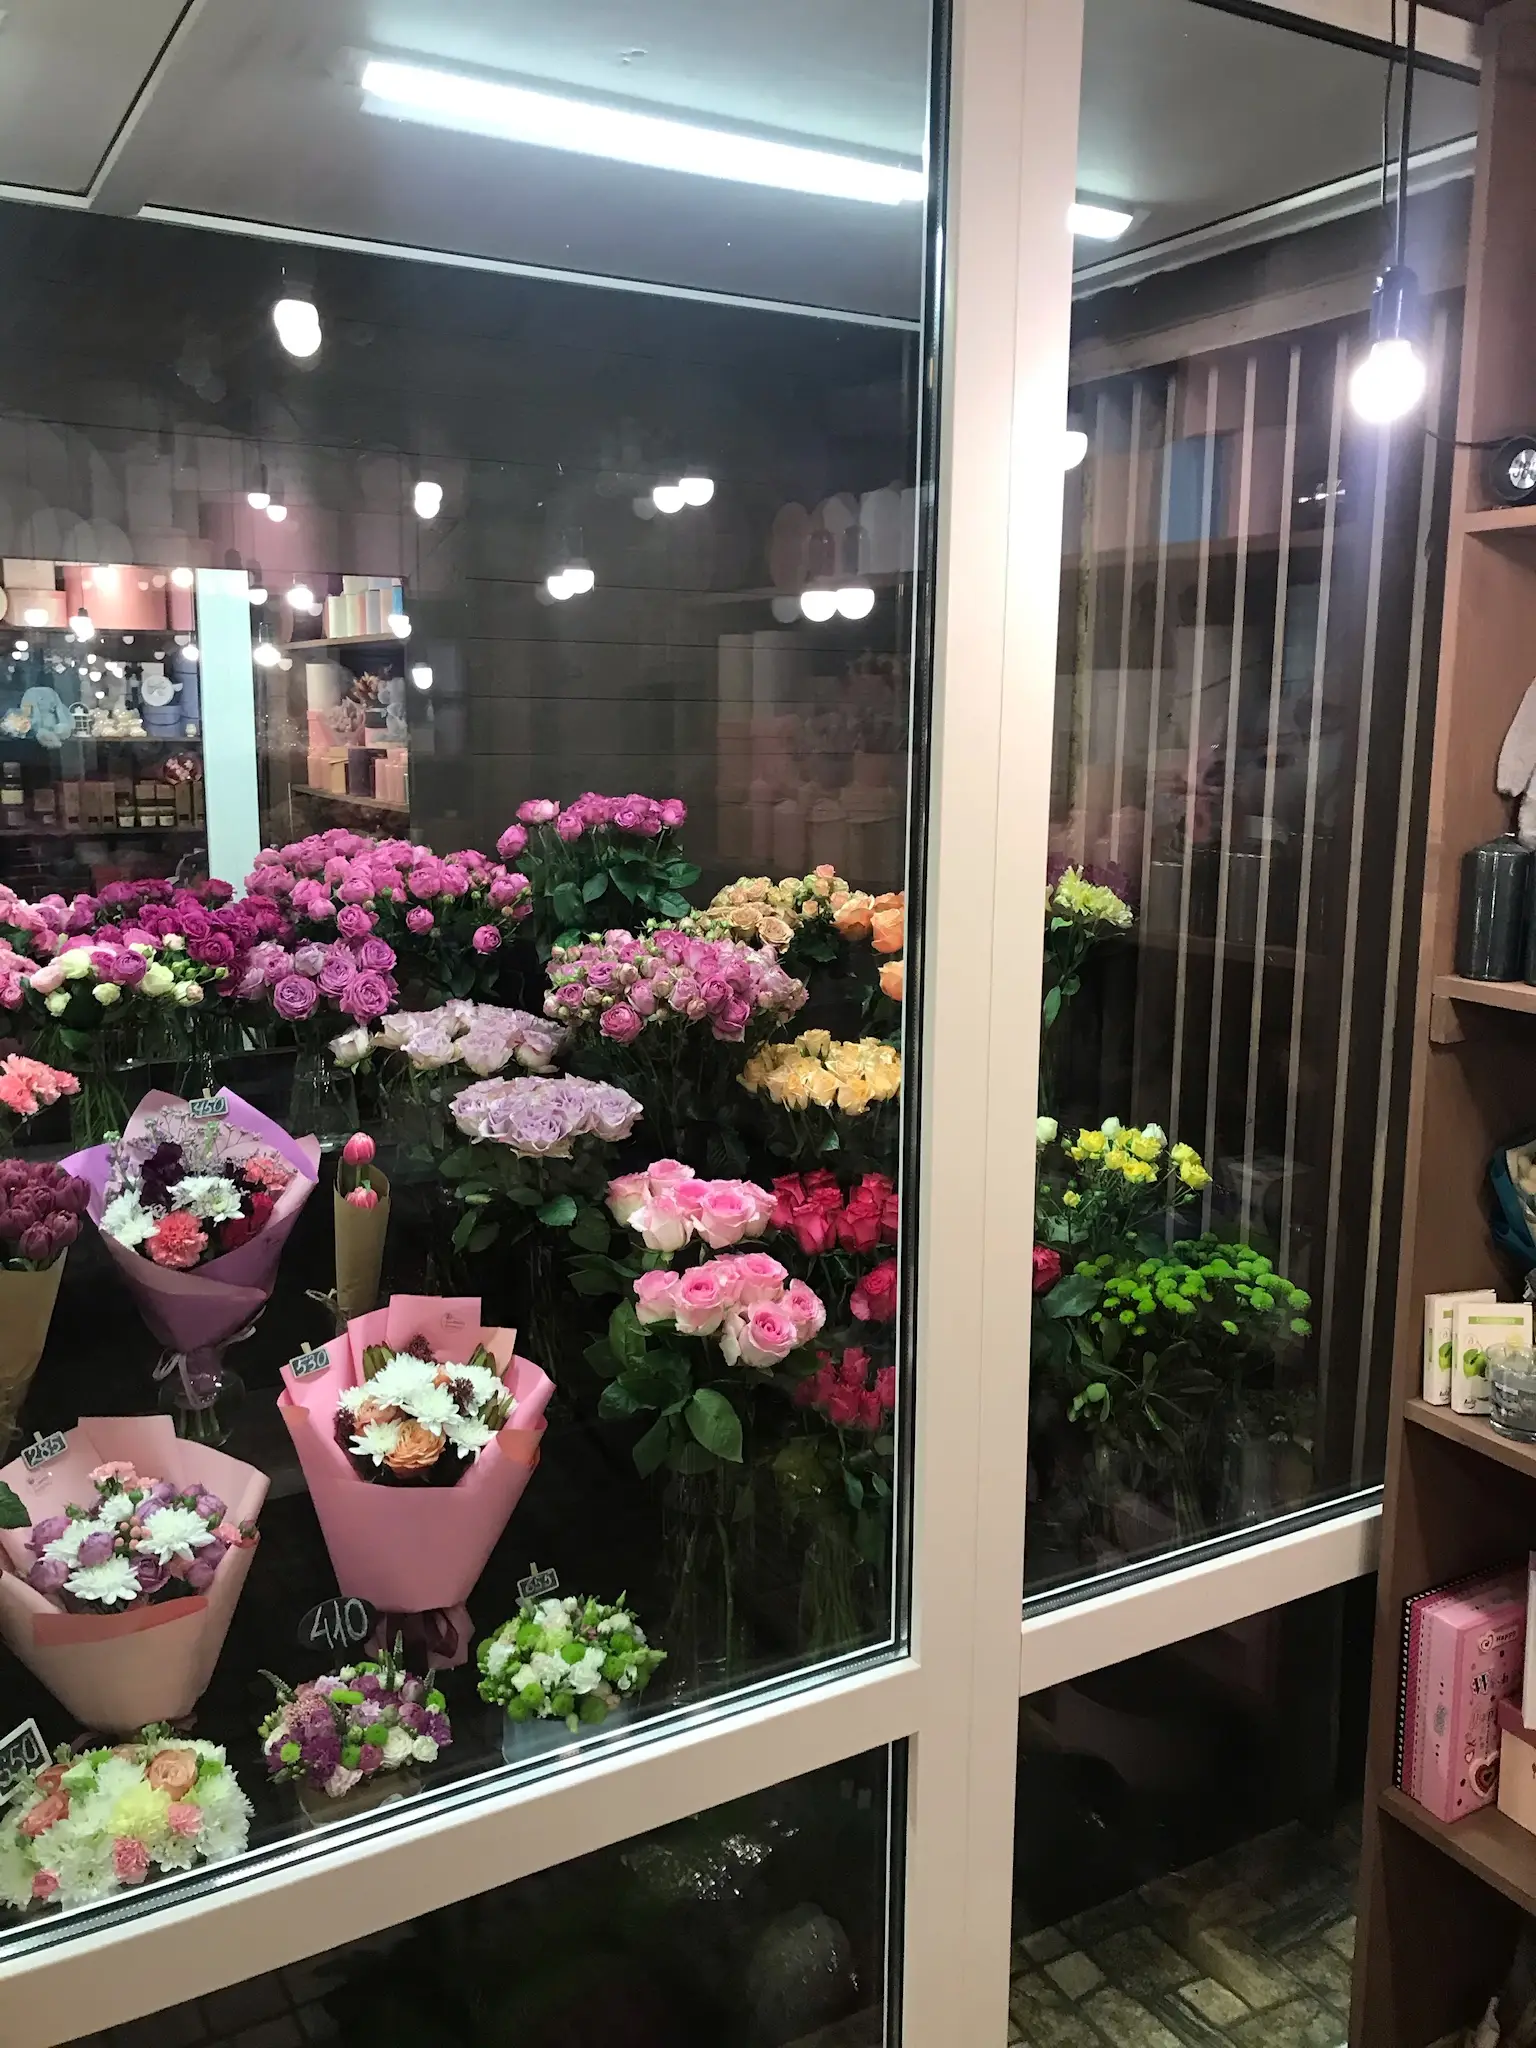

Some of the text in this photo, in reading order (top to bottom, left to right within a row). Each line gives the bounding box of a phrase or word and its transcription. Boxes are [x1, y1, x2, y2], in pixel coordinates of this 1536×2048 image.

[297, 1350, 326, 1376] 530
[28, 1435, 61, 1465] 285
[310, 1598, 368, 1649] 410
